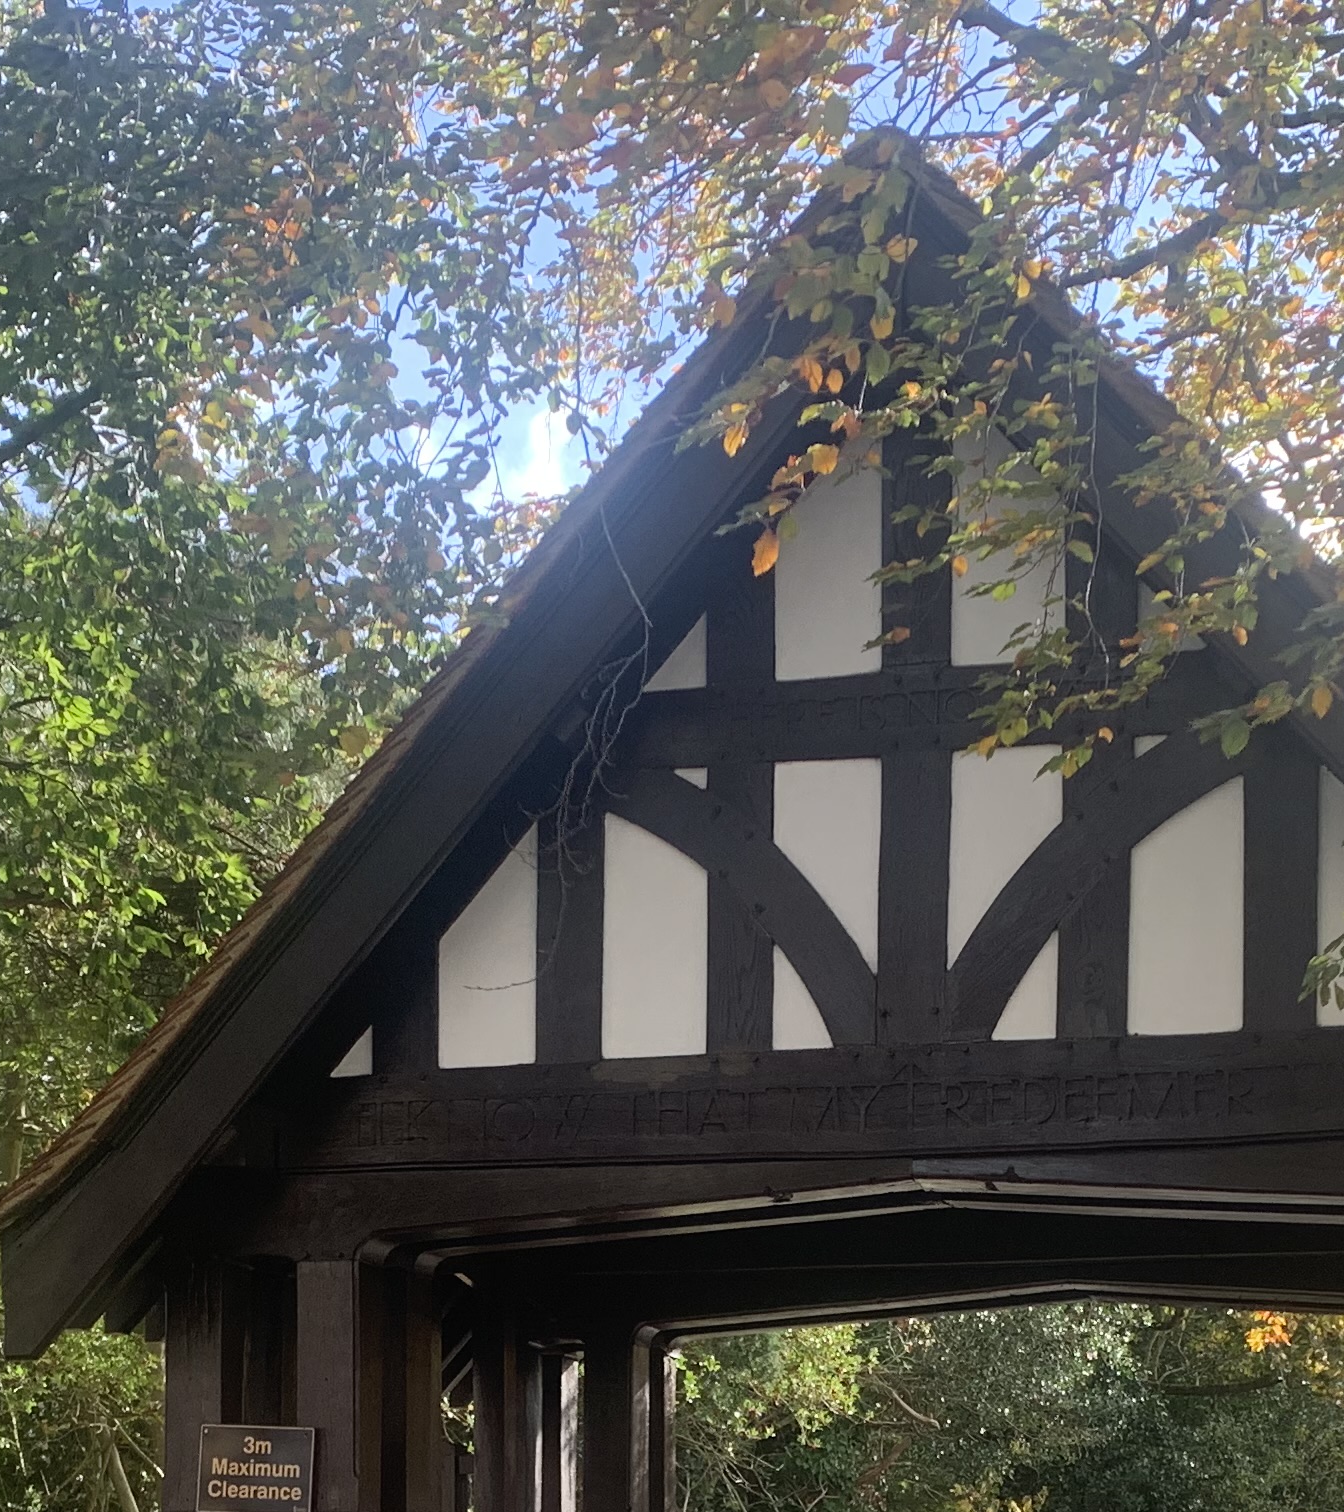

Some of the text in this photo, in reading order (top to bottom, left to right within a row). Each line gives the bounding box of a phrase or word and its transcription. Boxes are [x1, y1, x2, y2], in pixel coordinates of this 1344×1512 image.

[618, 1090, 766, 1138] THAT
[243, 1436, 272, 1454] 3m
[211, 1458, 300, 1478] Maximum
[207, 1480, 302, 1501] Clearance
